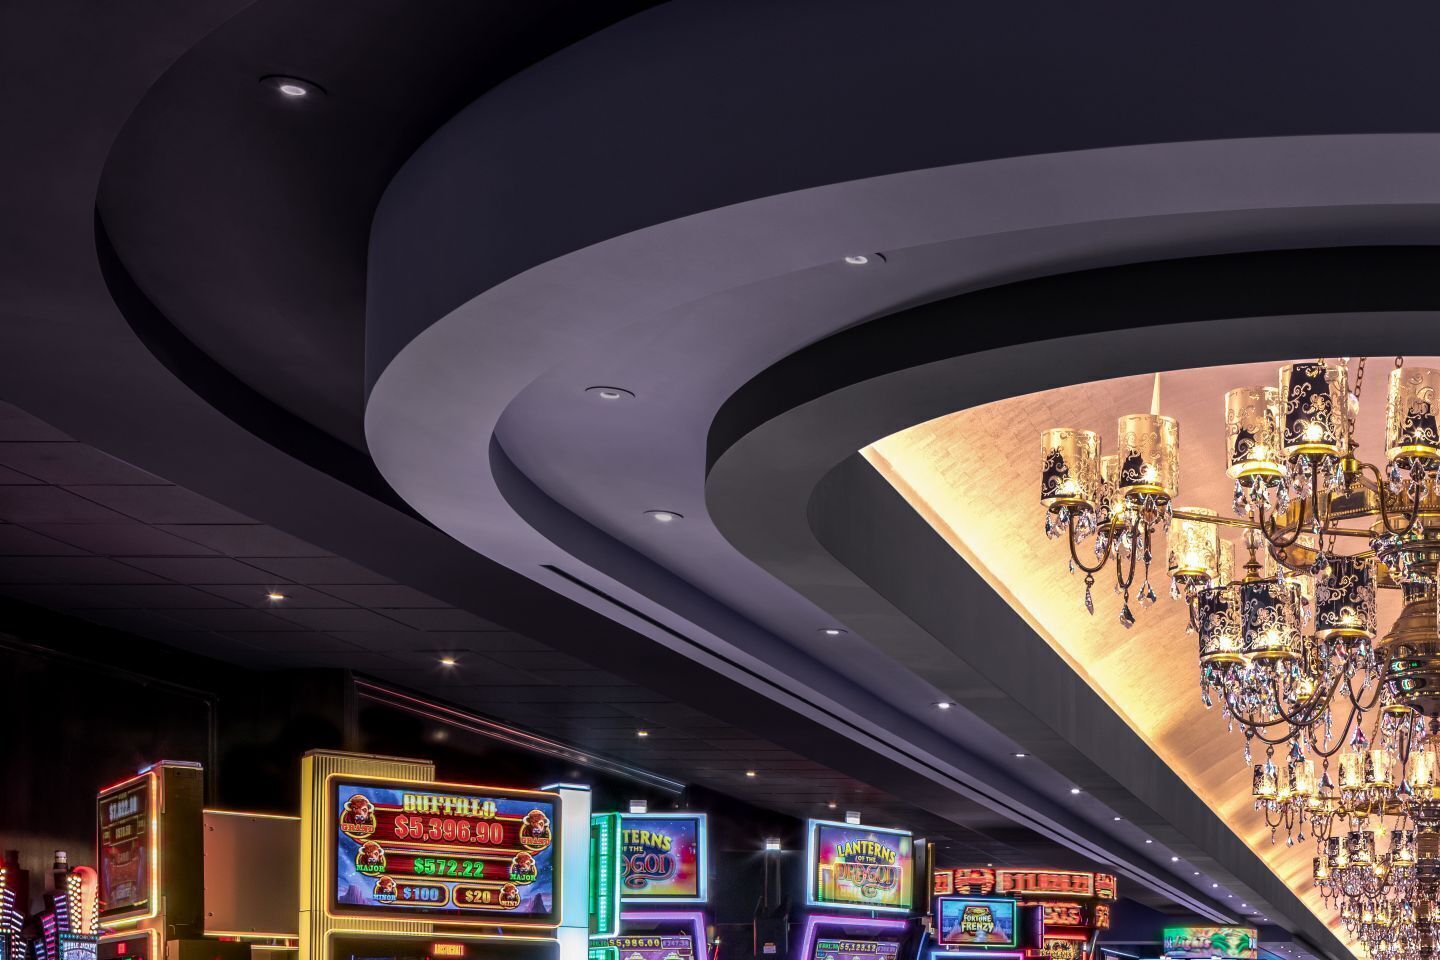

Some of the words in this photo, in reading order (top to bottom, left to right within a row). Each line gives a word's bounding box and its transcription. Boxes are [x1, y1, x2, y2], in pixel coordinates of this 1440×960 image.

[403, 793, 497, 819] BUFFALO
[340, 823, 375, 833] GRAND
[394, 814, 503, 844] $5,396.90
[622, 829, 672, 851] TERNS
[837, 840, 896, 865] LANTERNS
[356, 864, 385, 873] MAJOR
[413, 857, 485, 878] $572.22
[510, 873, 536, 881] MAJOR
[403, 887, 439, 900] $100
[465, 890, 491, 904] $20
[963, 914, 992, 923] FORTUNE
[961, 921, 995, 932] FRENZY
